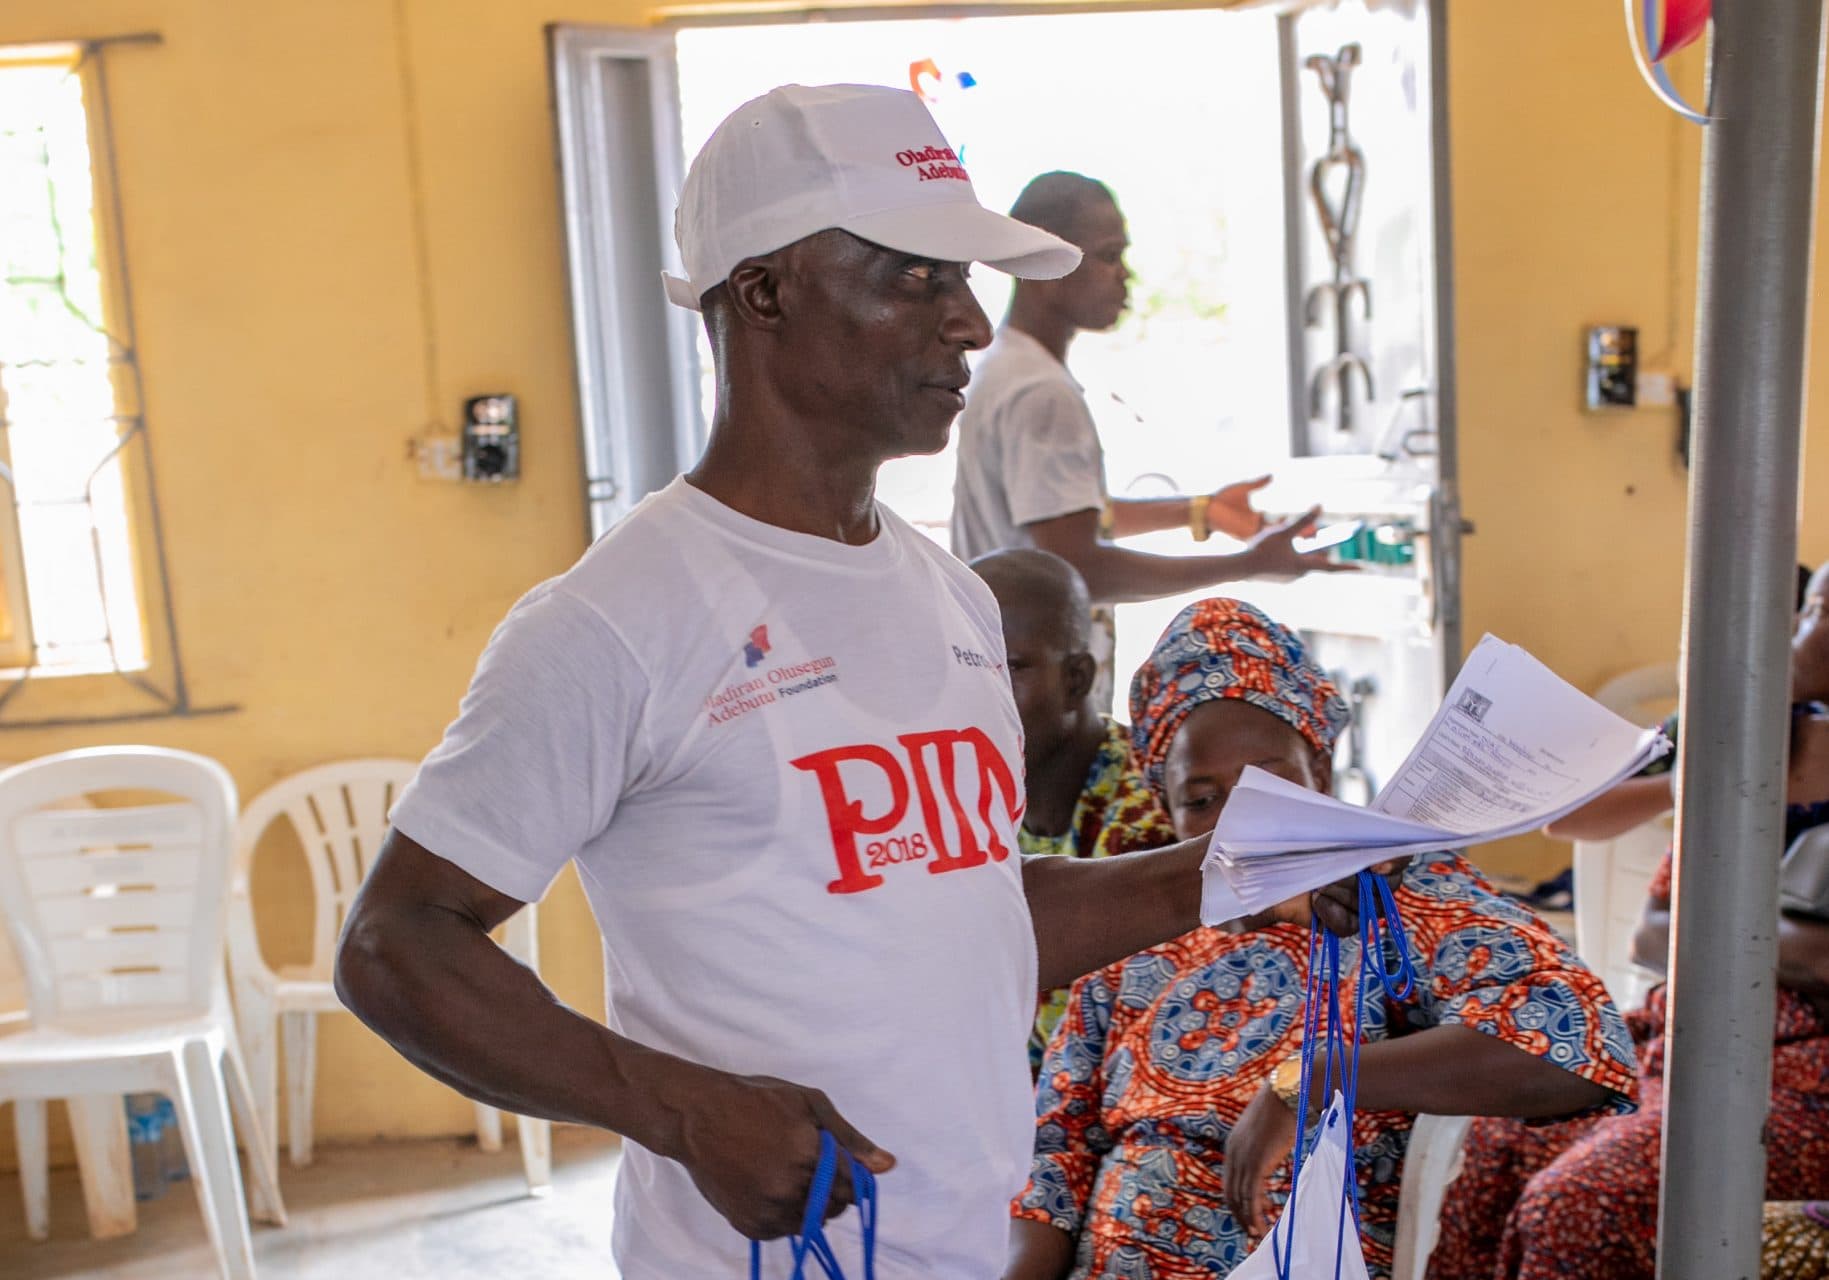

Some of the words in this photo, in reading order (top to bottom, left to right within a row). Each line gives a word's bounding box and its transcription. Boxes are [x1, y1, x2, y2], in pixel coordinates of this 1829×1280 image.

[767, 656, 836, 684] Olusegun
[708, 691, 777, 728] Adebutu
[778, 674, 838, 698] Foundation
[866, 833, 928, 869] 2018
